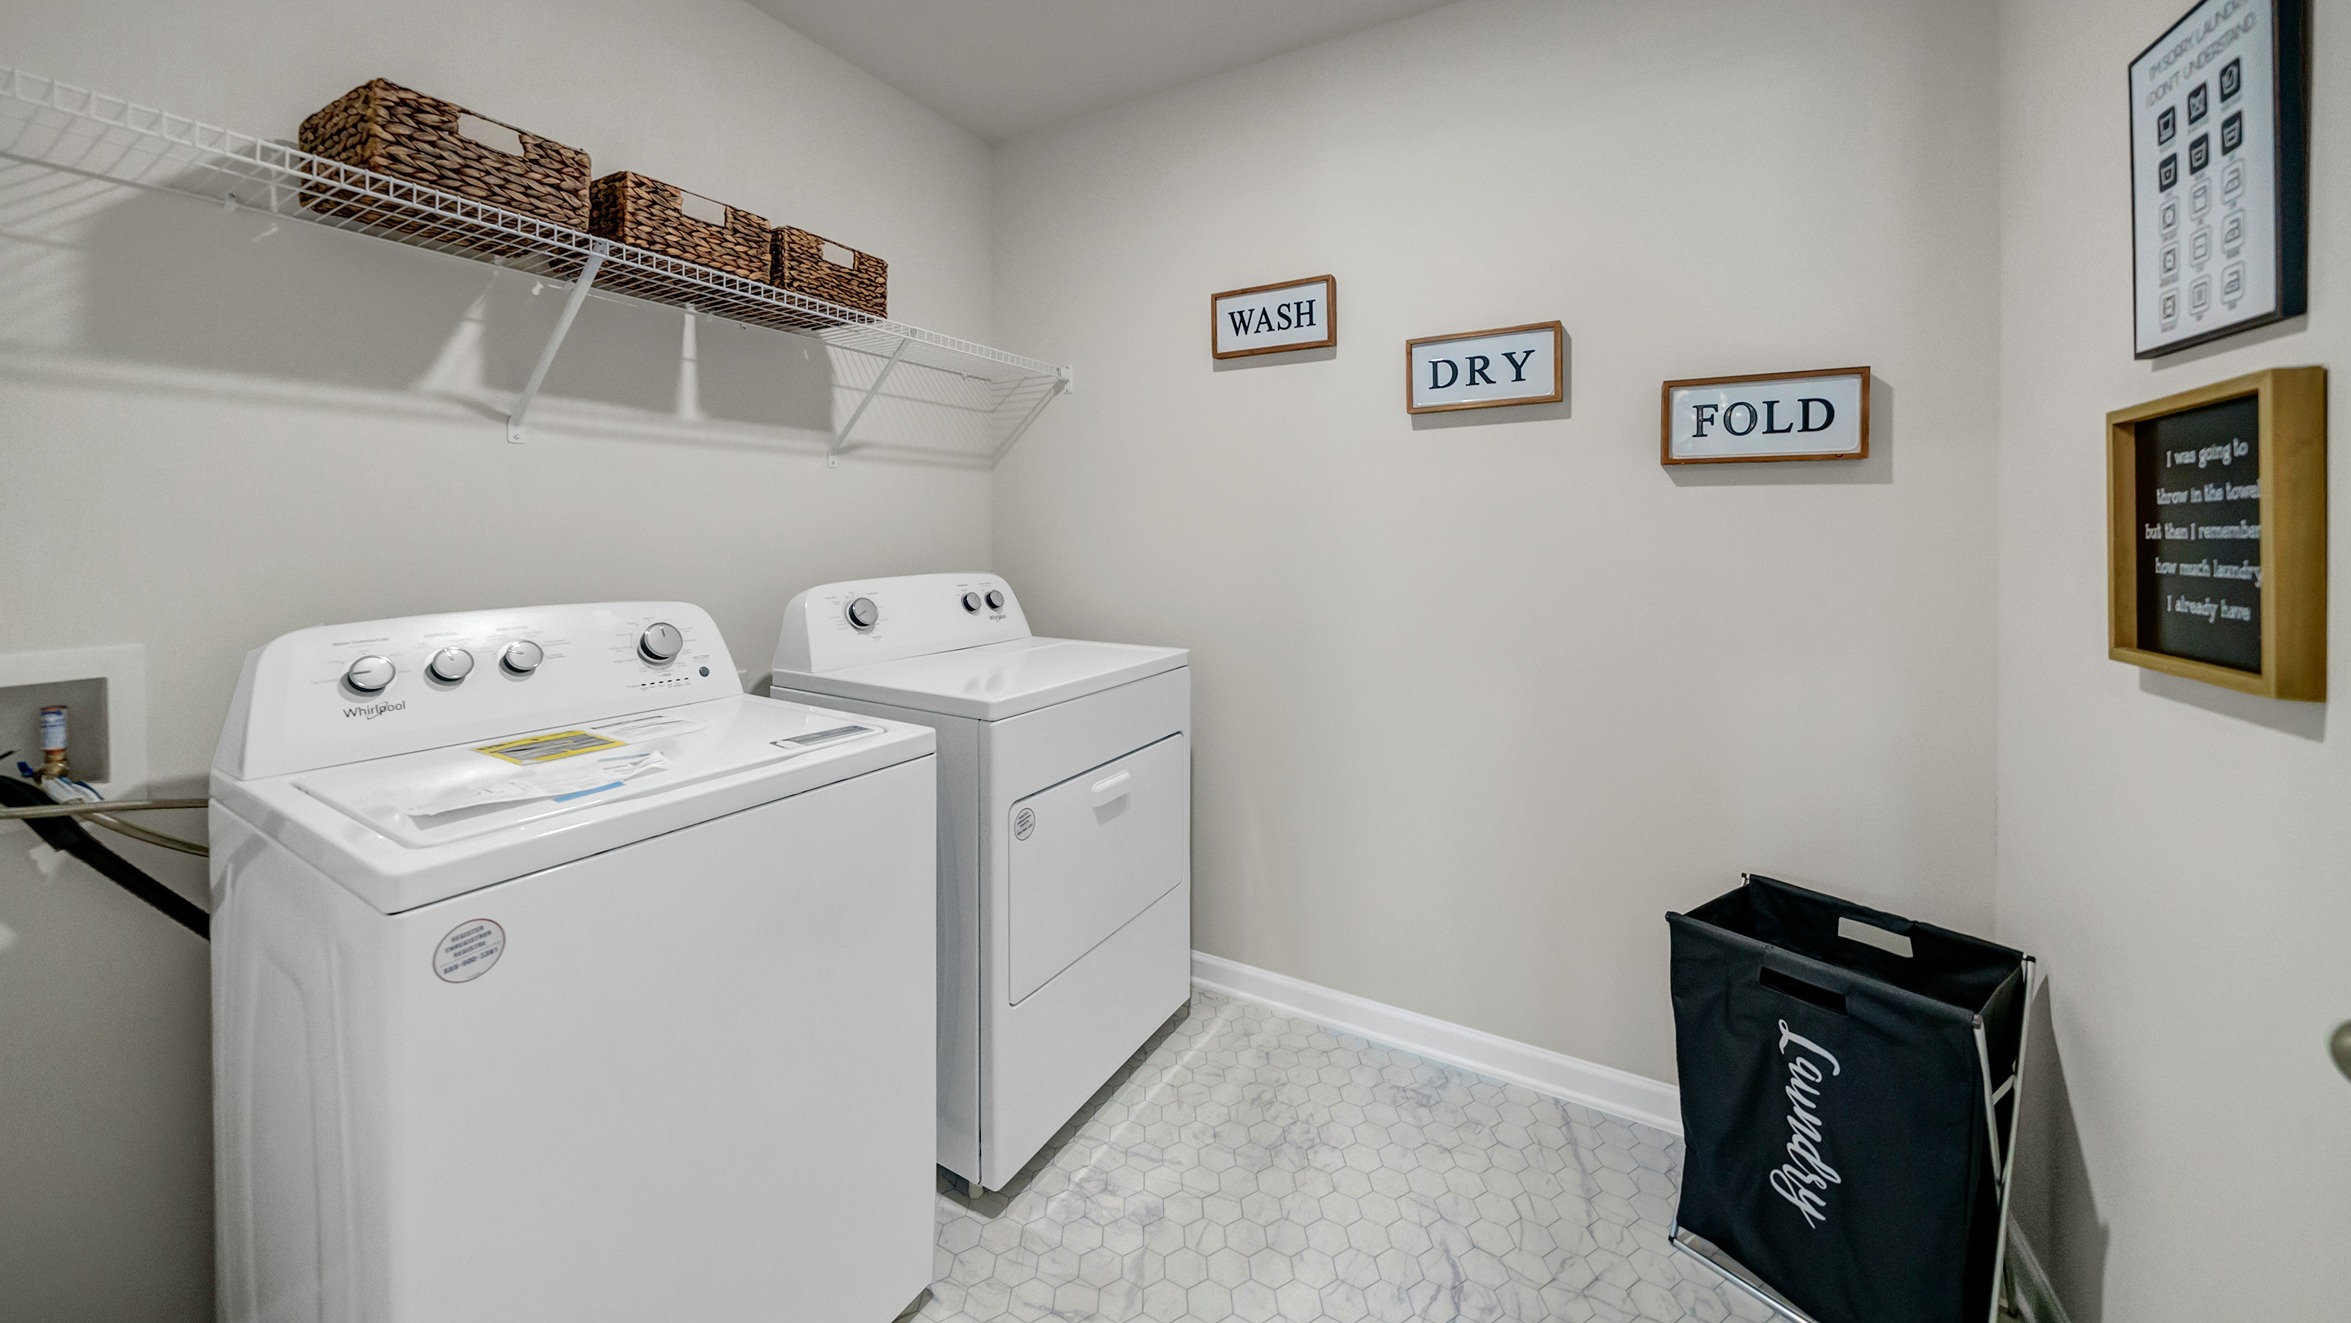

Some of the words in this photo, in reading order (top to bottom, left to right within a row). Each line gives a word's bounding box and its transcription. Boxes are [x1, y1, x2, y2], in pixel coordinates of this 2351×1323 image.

[2195, 0, 2249, 43] LAUND
[2182, 10, 2257, 80] UNDERSTAND
[1227, 299, 1317, 337] WASH
[1428, 349, 1536, 390] DRY
[1691, 397, 1836, 438] FOLD
[2166, 450, 2172, 468] I
[2173, 450, 2197, 465] was
[2198, 443, 2232, 469] going
[2232, 437, 2249, 458] to
[2156, 487, 2188, 506] throw
[2190, 487, 2203, 503] in
[2203, 482, 2224, 502] the
[2144, 522, 2162, 540] but
[2164, 522, 2189, 540] then
[2190, 522, 2196, 540] I
[2155, 556, 2178, 575] how
[2179, 558, 2211, 578] much
[2213, 559, 2263, 589] laundry
[2167, 594, 2173, 612] I
[2174, 594, 2219, 624] already
[2220, 599, 2252, 622] have
[342, 699, 406, 720] Whirlpool
[1769, 1018, 1842, 1229] Laundry
